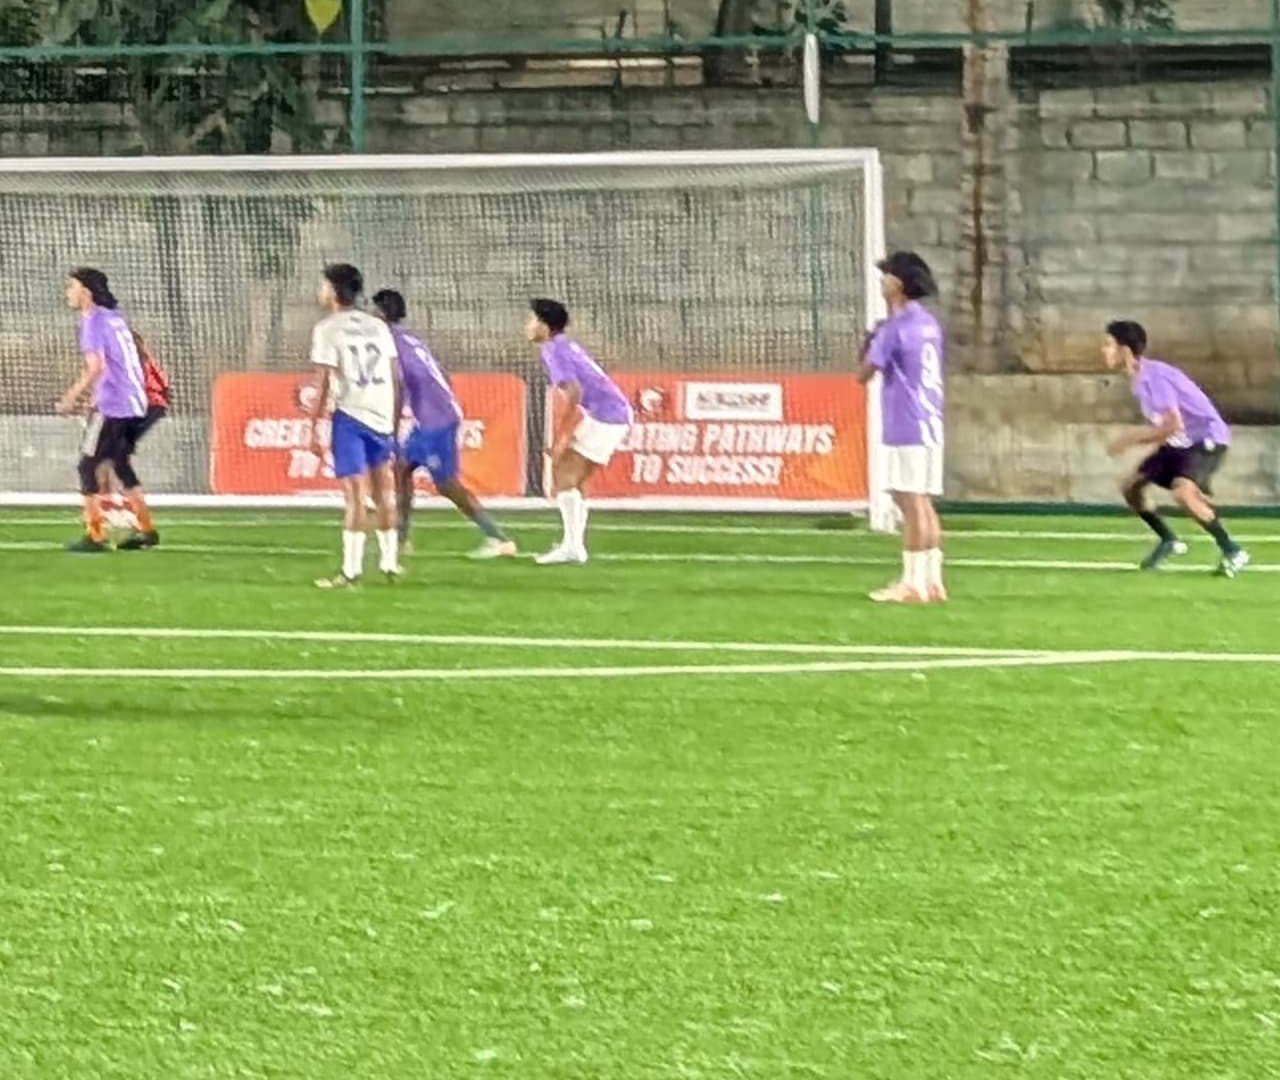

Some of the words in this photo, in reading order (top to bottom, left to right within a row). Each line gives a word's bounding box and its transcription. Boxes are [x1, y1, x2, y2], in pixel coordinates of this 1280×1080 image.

[348, 342, 386, 387] 12
[920, 341, 940, 388] 9
[702, 423, 836, 454] PATHWAYS
[631, 453, 663, 484] TO
[665, 454, 784, 486] SUCCESS!
